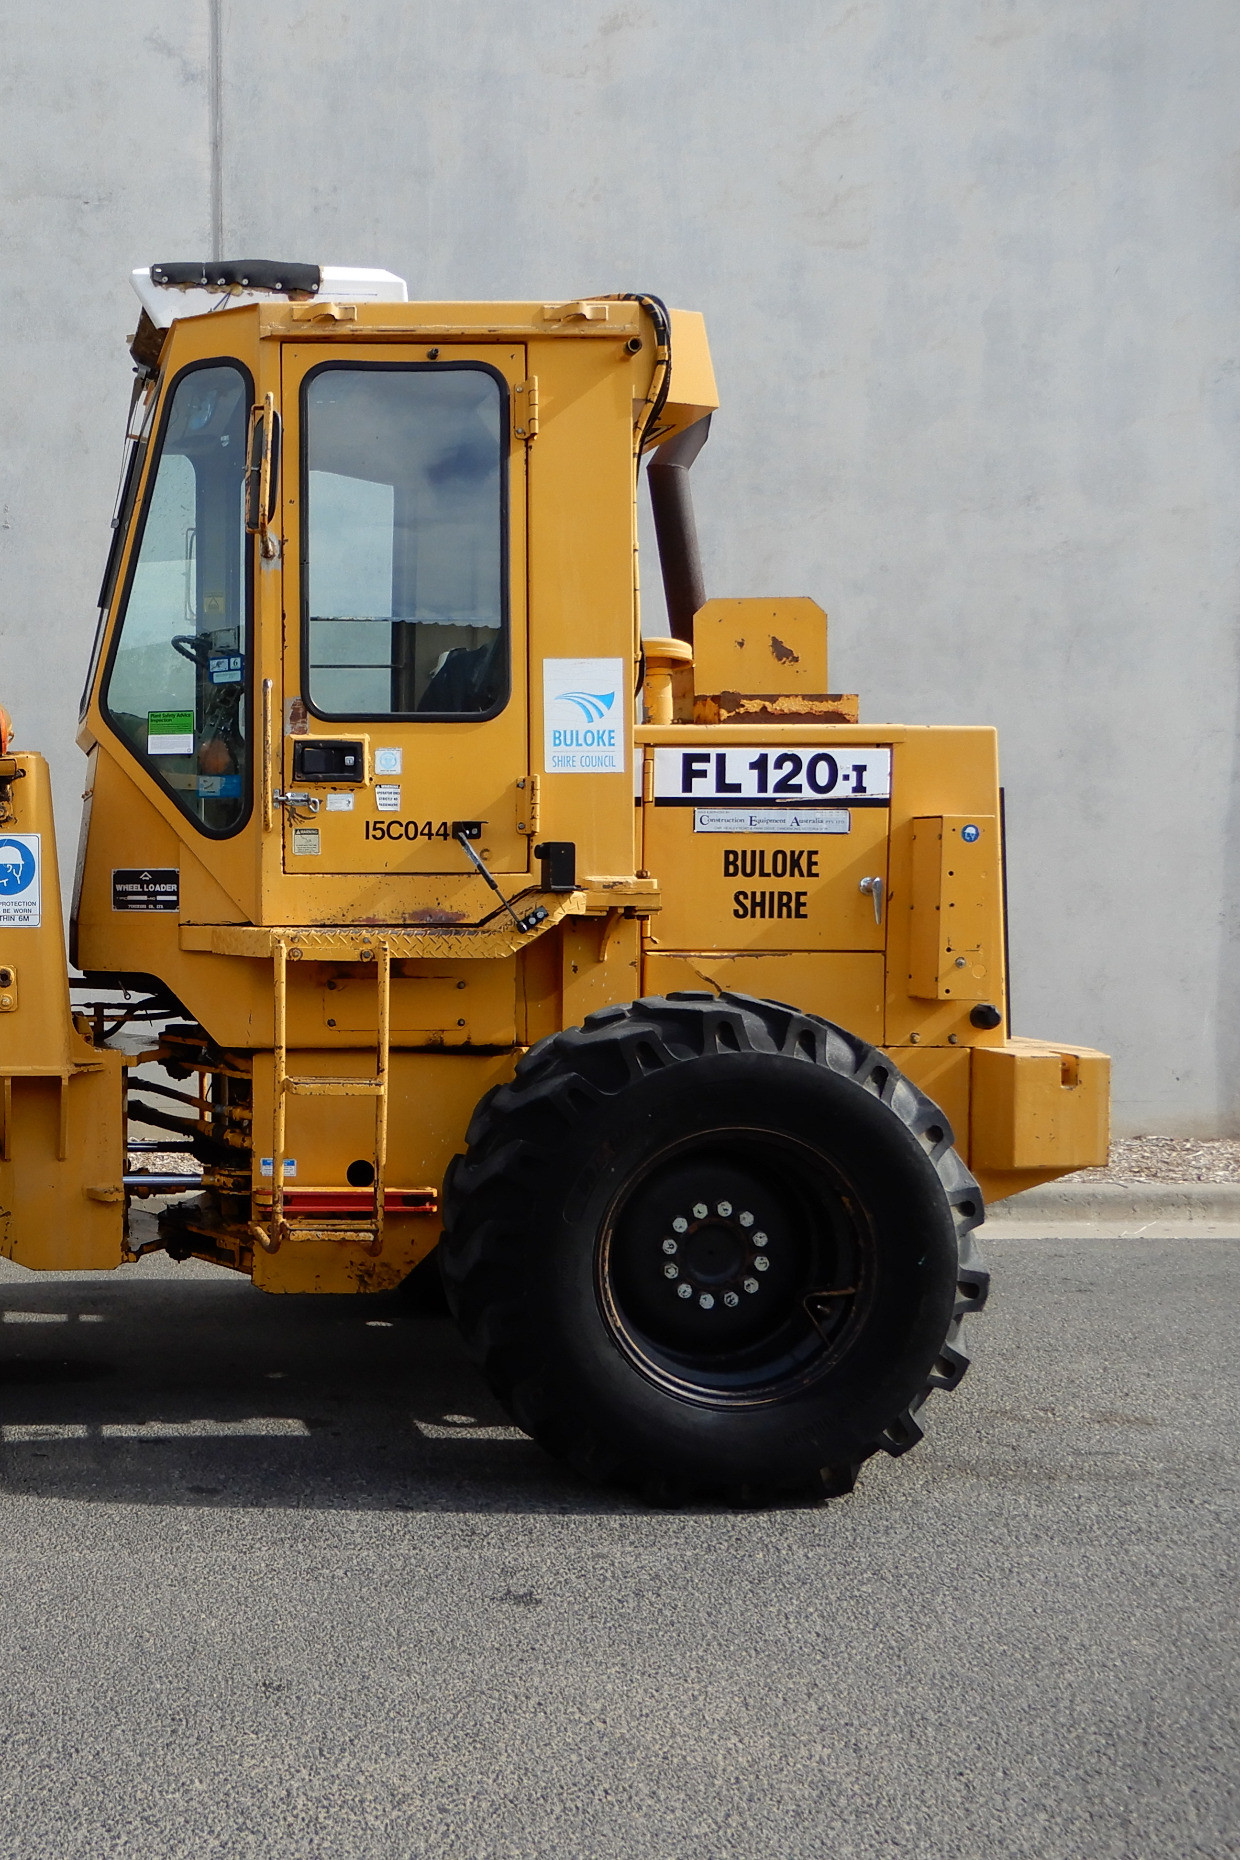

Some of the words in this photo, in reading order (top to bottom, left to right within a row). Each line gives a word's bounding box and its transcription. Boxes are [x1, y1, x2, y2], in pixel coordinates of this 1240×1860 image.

[552, 729, 616, 747] BULOKE
[552, 755, 577, 768] SHIRE
[580, 755, 616, 768] COUNCIL
[699, 814, 745, 826] Construction
[790, 816, 824, 827] Australia
[723, 849, 819, 878] BULOKE
[733, 890, 808, 919] SHIRE
